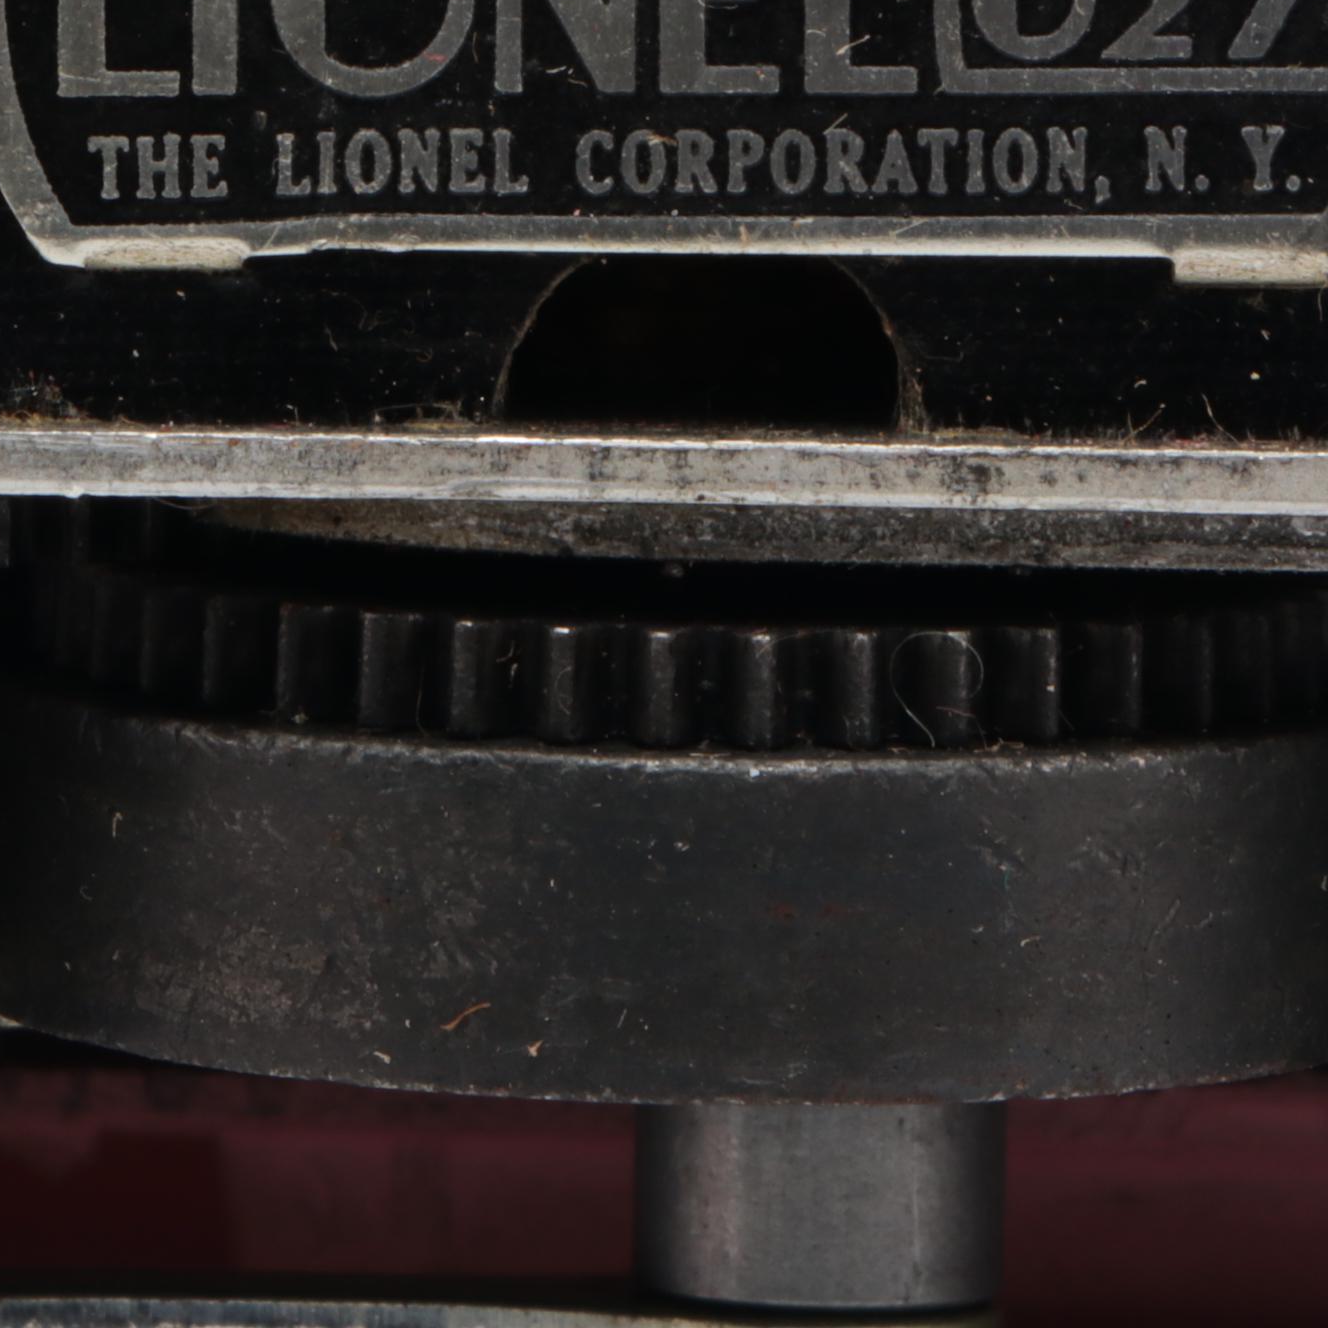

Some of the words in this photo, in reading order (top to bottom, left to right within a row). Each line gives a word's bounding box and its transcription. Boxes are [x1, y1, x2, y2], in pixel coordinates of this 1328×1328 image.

[87, 131, 229, 201] THE
[275, 126, 530, 199] LIONEL
[575, 124, 1112, 205] CORPORATION,
